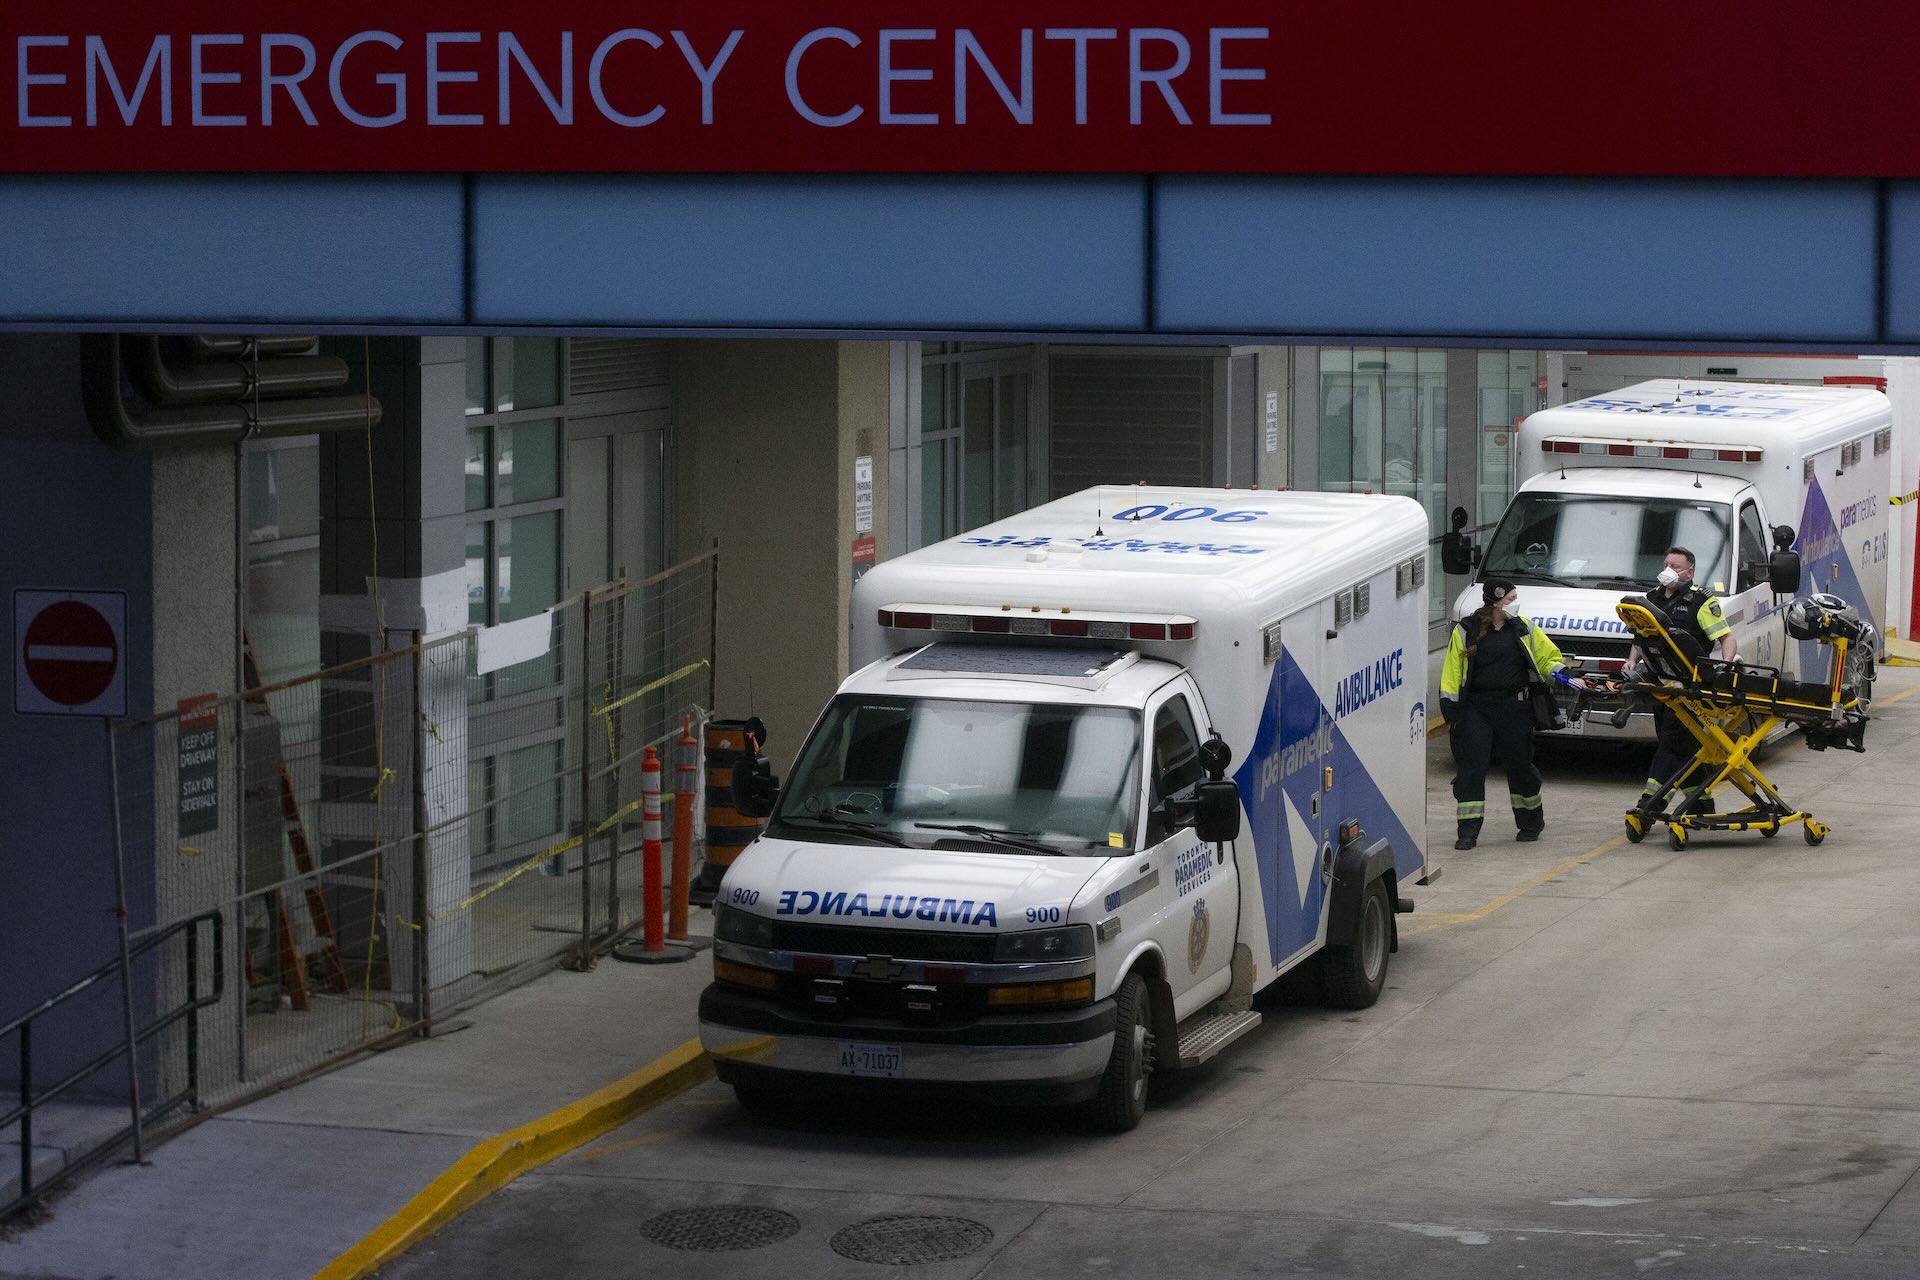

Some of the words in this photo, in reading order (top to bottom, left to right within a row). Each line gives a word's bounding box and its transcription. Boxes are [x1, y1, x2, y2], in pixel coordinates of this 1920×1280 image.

[16, 28, 745, 128] EMERGENCY
[784, 26, 1272, 127] CENTRE
[1111, 504, 1268, 523] 900
[958, 535, 1266, 554] PARAMDIC
[1334, 648, 1403, 721] AMBULANCE
[180, 733, 200, 751] KEEP
[200, 730, 215, 746] OFF
[180, 747, 217, 768] DRIVEWAY
[1260, 714, 1336, 802] paramedic
[182, 779, 201, 796] STAY
[201, 776, 215, 792] ON
[181, 792, 217, 813] SIDEWALK
[1177, 841, 1209, 864] TORONTO
[1174, 849, 1213, 887] PARAMEDIC
[1179, 870, 1211, 898] SERVICES
[733, 887, 760, 906] 900
[1106, 890, 1121, 912] 900
[1025, 906, 1061, 923] 900
